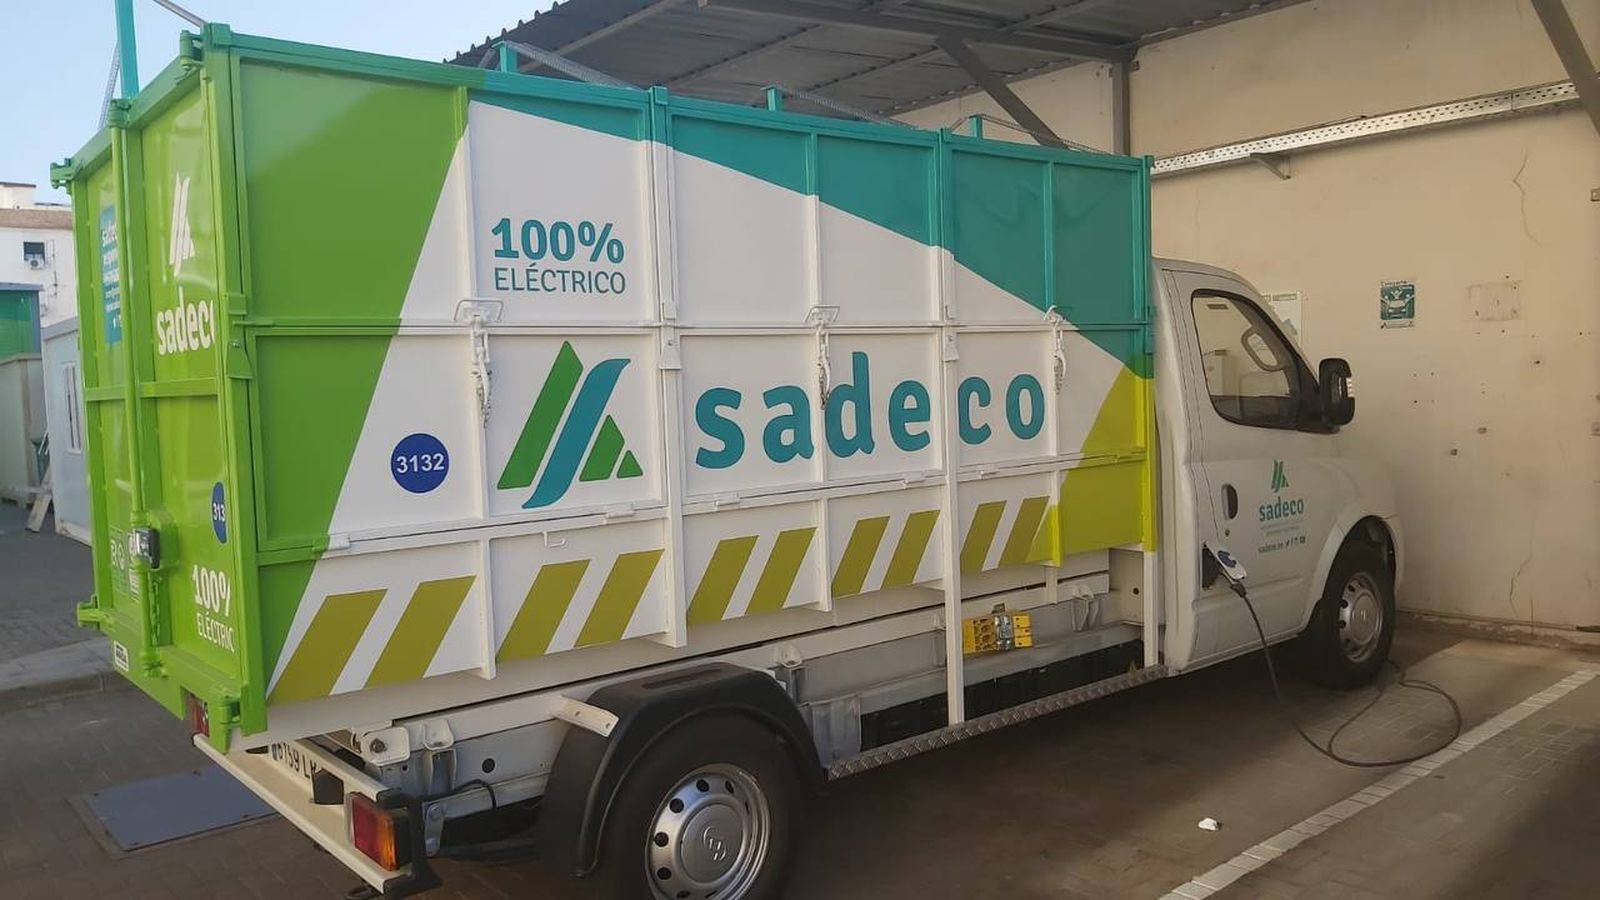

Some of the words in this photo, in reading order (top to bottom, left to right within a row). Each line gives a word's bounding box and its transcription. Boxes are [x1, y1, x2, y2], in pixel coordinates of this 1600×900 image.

[491, 217, 625, 264] 100%
[494, 262, 626, 294] ELÉCTRICO
[695, 351, 1045, 469] sadeco
[396, 453, 444, 473] 3132
[213, 502, 225, 521] 313
[1258, 496, 1304, 522] sadeco
[197, 611, 235, 653] ELÉCTRIC
